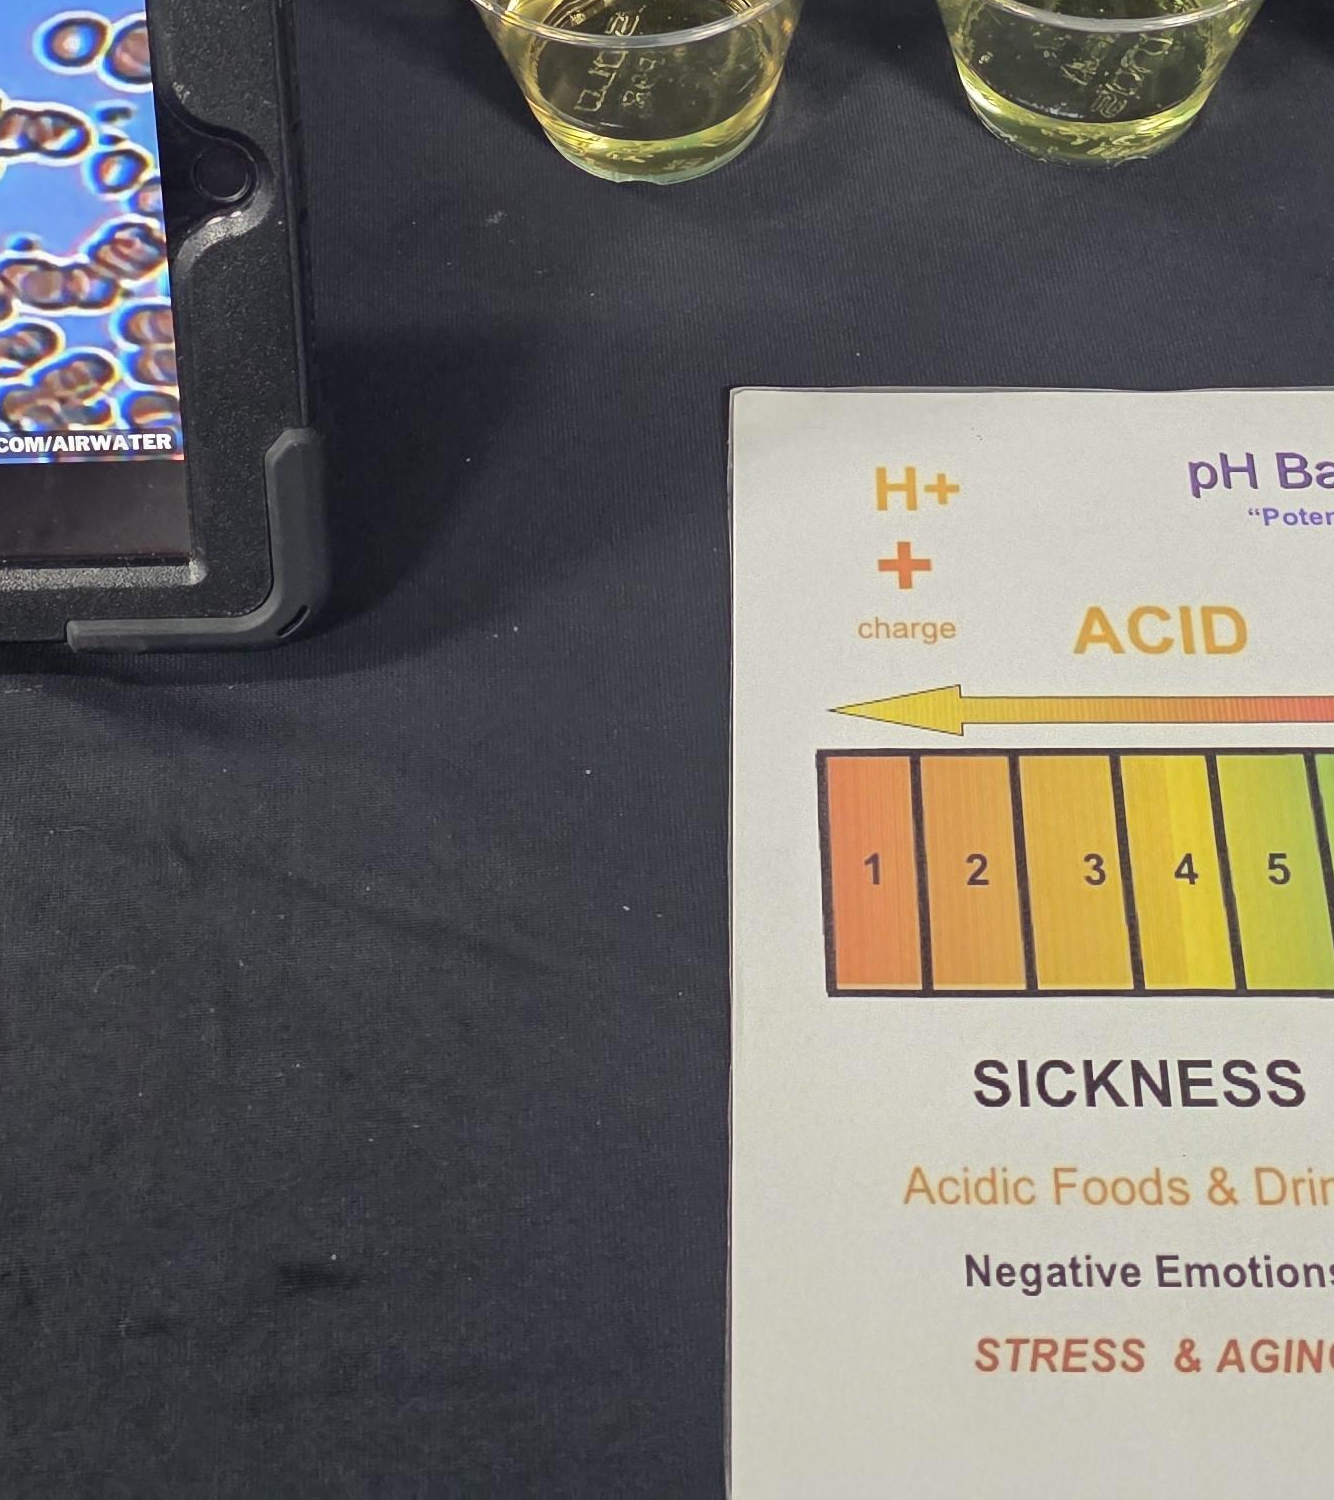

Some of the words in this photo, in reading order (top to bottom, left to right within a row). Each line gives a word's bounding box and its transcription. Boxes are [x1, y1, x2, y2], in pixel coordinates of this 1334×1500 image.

[875, 465, 961, 512] H+
[1188, 452, 1258, 499] pH
[856, 616, 958, 646] charge
[1073, 604, 1249, 656] ACID
[864, 853, 881, 885] 1
[966, 853, 990, 885] 2
[1084, 853, 1107, 885] 3
[1175, 853, 1198, 884] 4
[1267, 853, 1291, 884] 5
[974, 1059, 1306, 1108] SICKNESS
[903, 1165, 1036, 1206] Acidic
[1051, 1164, 1194, 1208] Foods
[1206, 1165, 1239, 1206] &
[965, 1254, 1141, 1297] Negative
[975, 1337, 1146, 1373] STRESS
[1174, 1338, 1202, 1374] &
